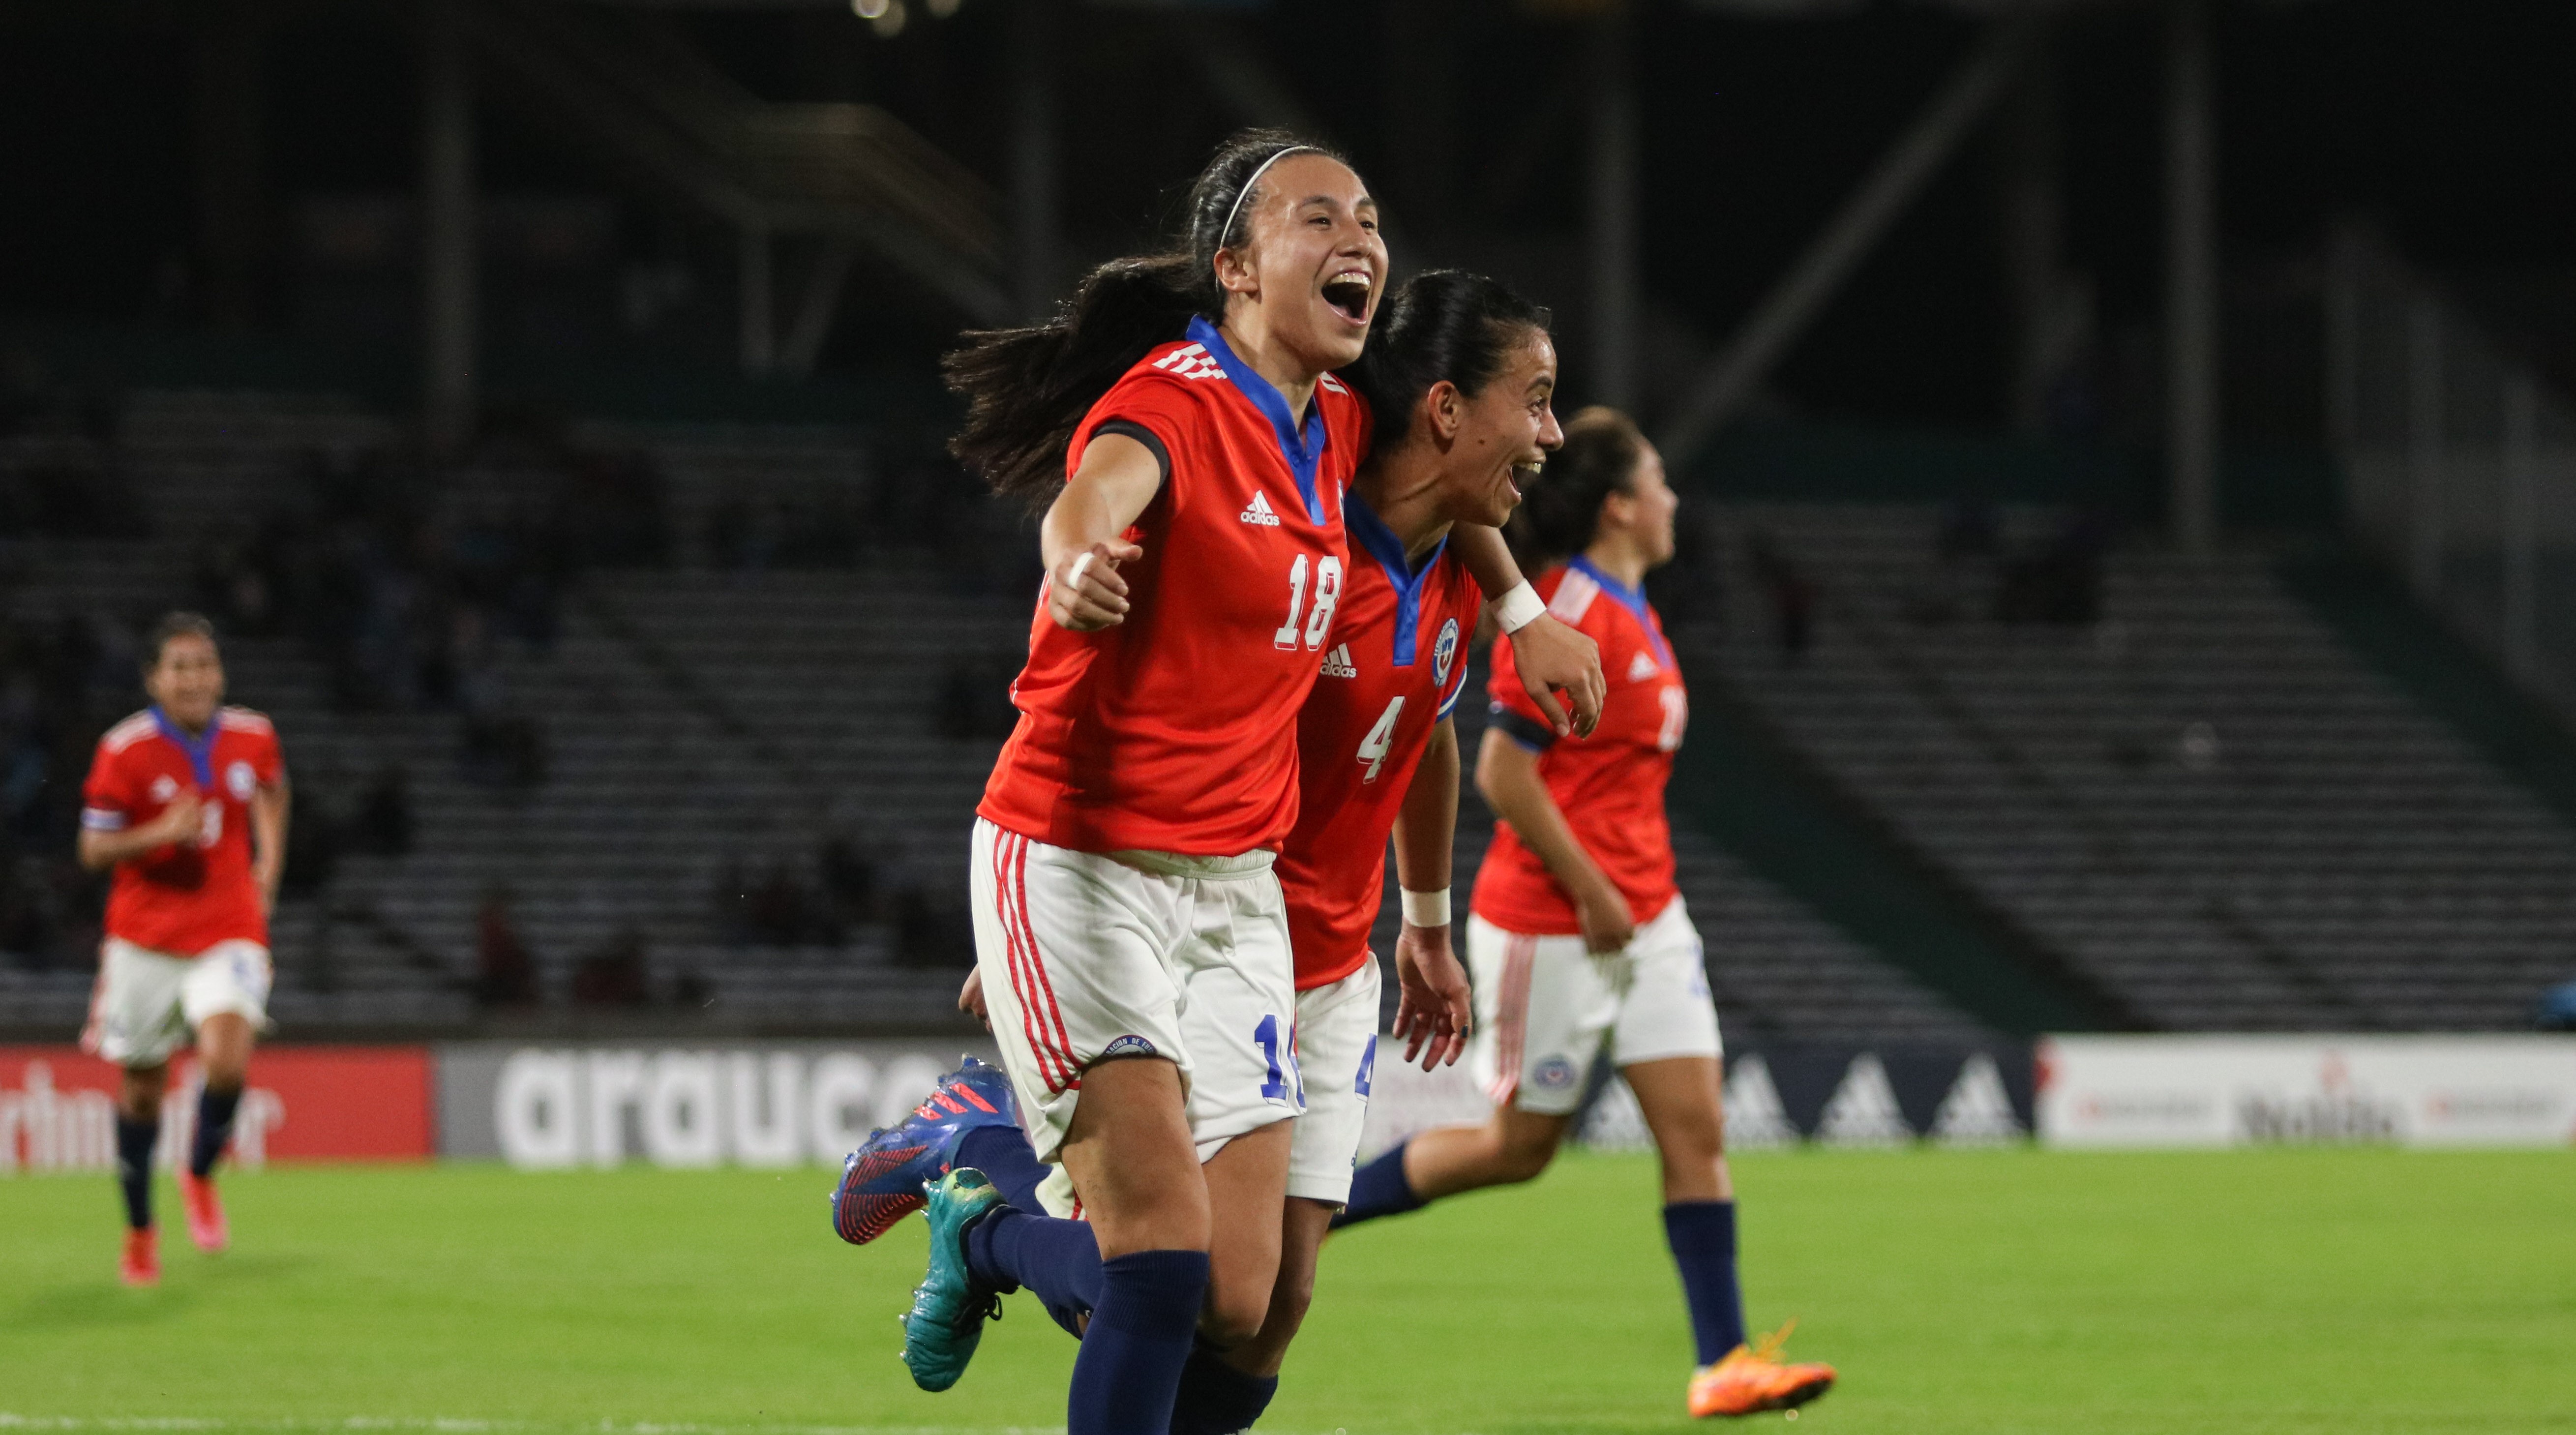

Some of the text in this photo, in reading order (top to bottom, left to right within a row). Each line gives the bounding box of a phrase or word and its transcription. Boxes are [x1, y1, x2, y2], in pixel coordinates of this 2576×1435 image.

[1240, 511, 1280, 526] adidas
[1274, 554, 1343, 651] 18
[1320, 662, 1357, 678] didas
[1356, 696, 1406, 784] 4
